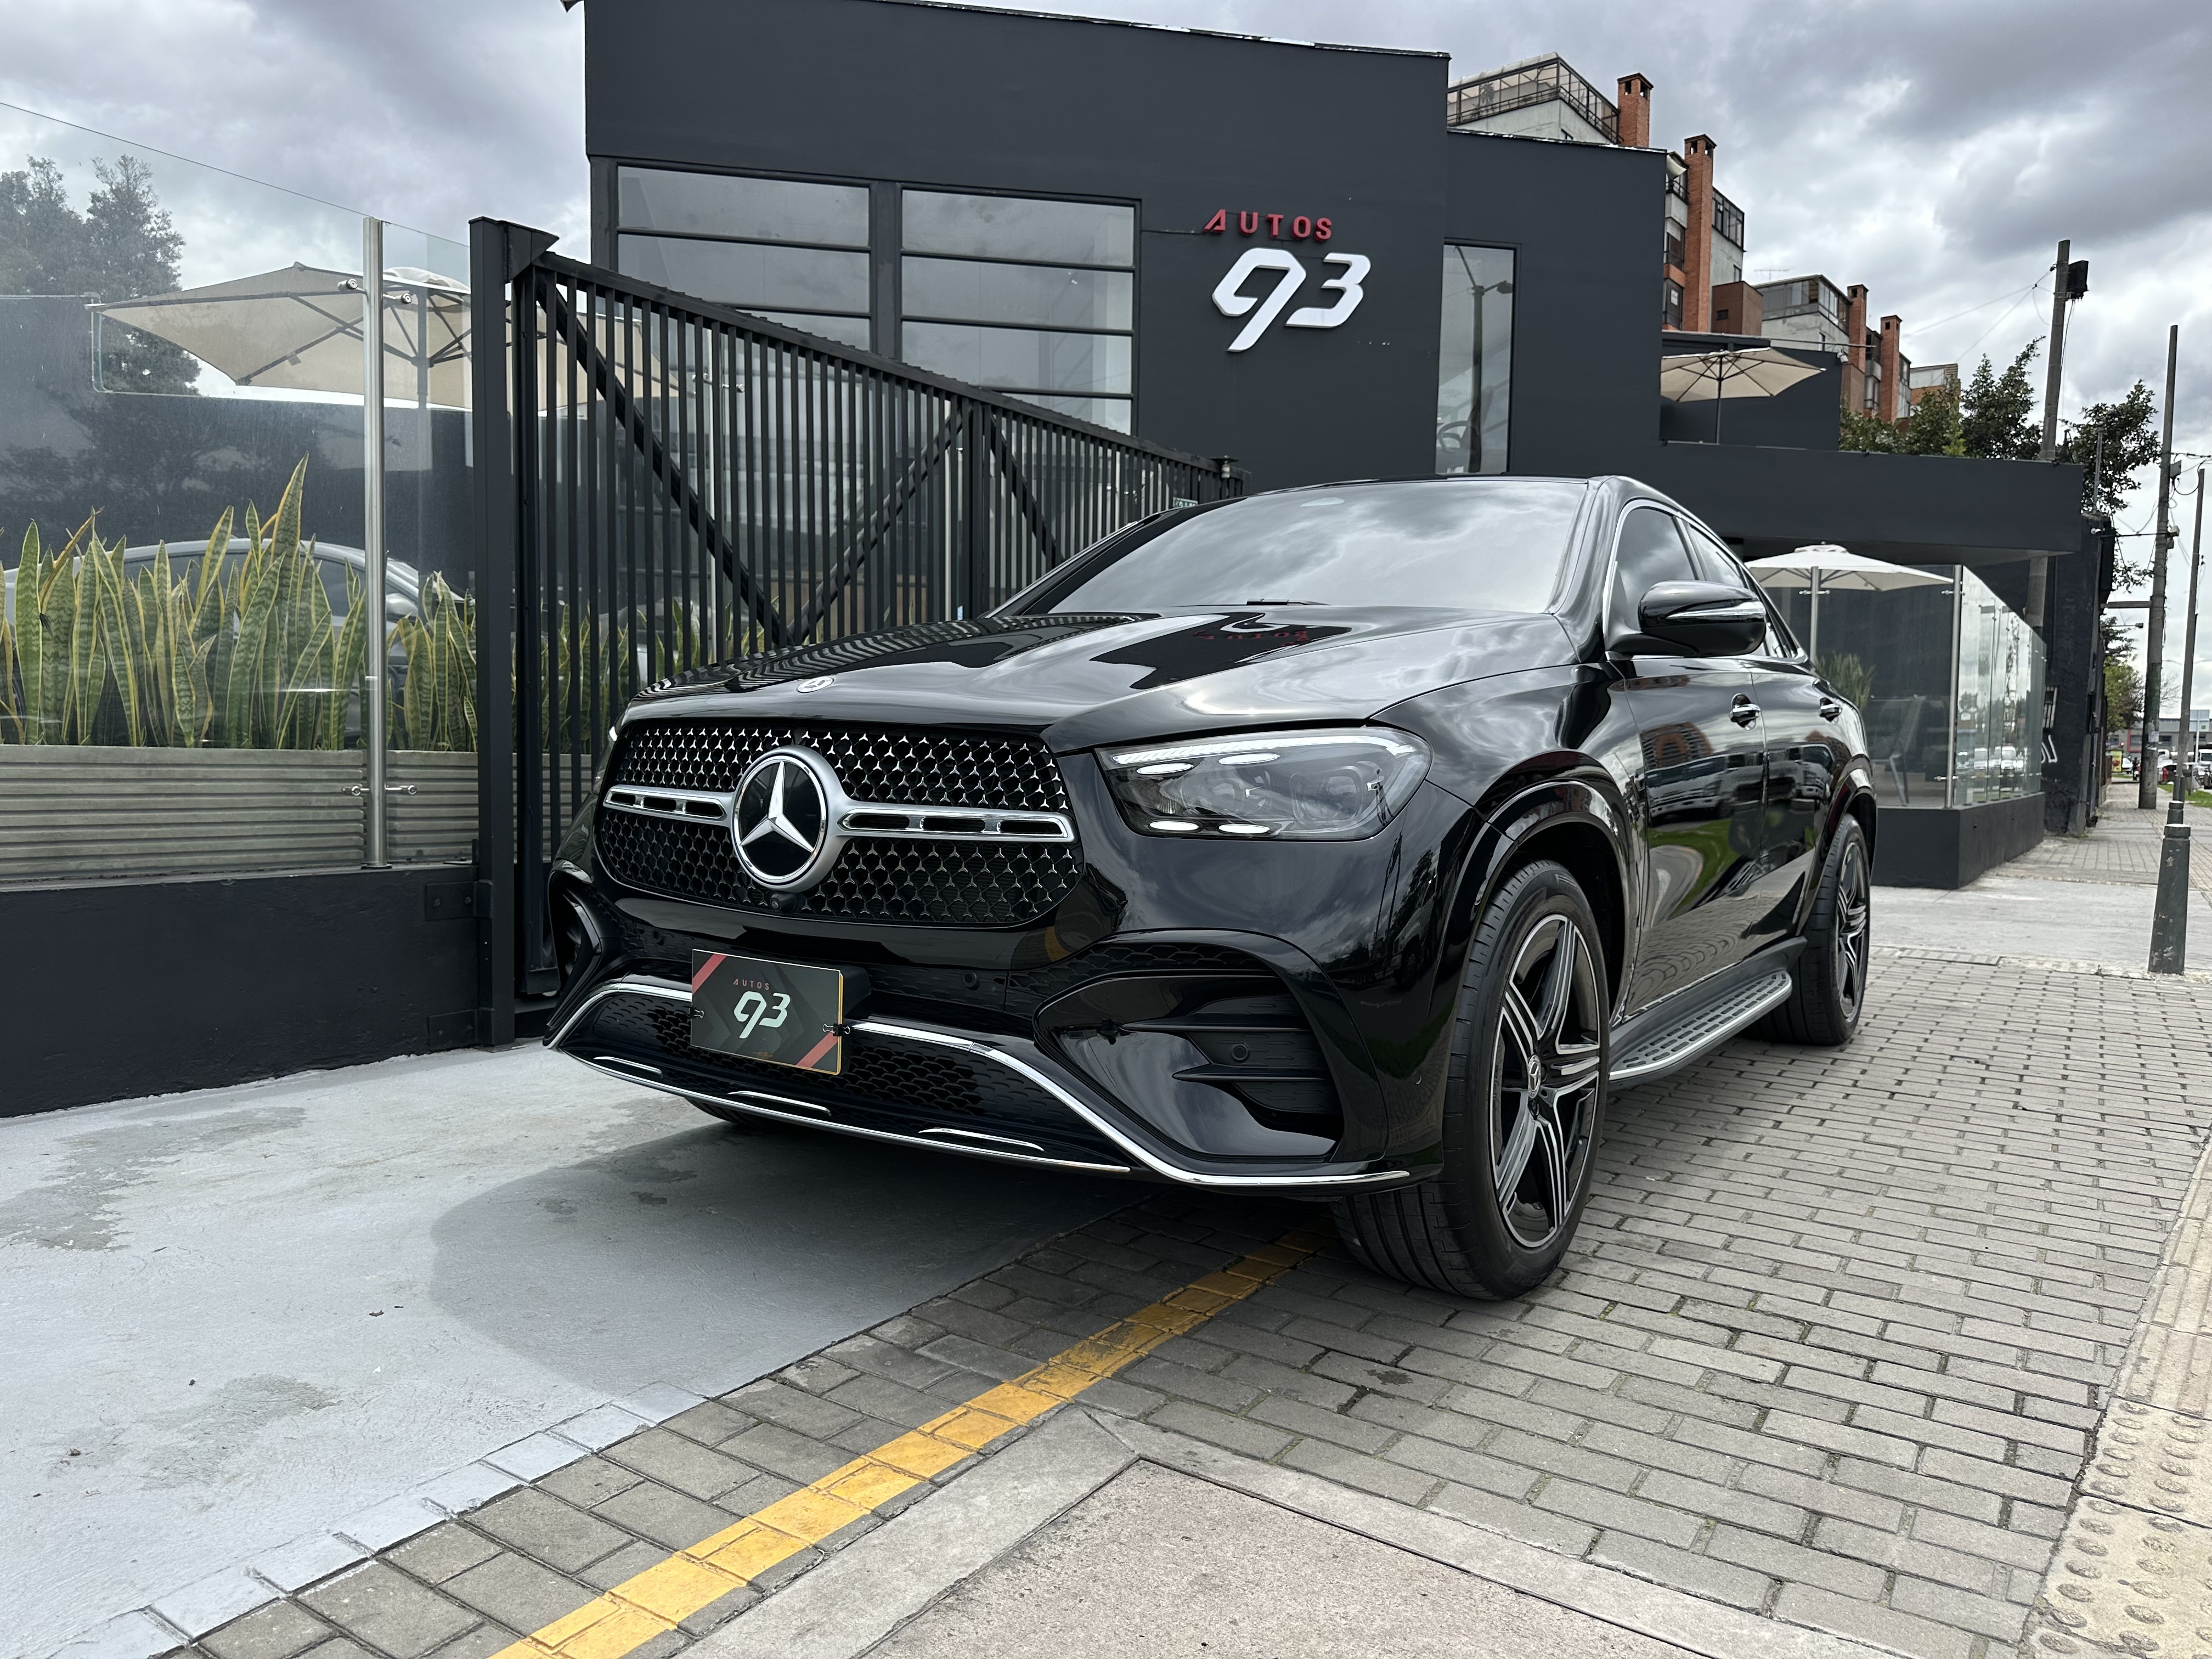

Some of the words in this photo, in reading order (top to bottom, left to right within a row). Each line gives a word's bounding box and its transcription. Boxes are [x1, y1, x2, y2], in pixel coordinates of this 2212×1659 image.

[1203, 208, 1333, 241] AUTOS
[1211, 247, 1372, 352] 93
[733, 978, 770, 990] AUTOS
[733, 991, 791, 1039] 93
